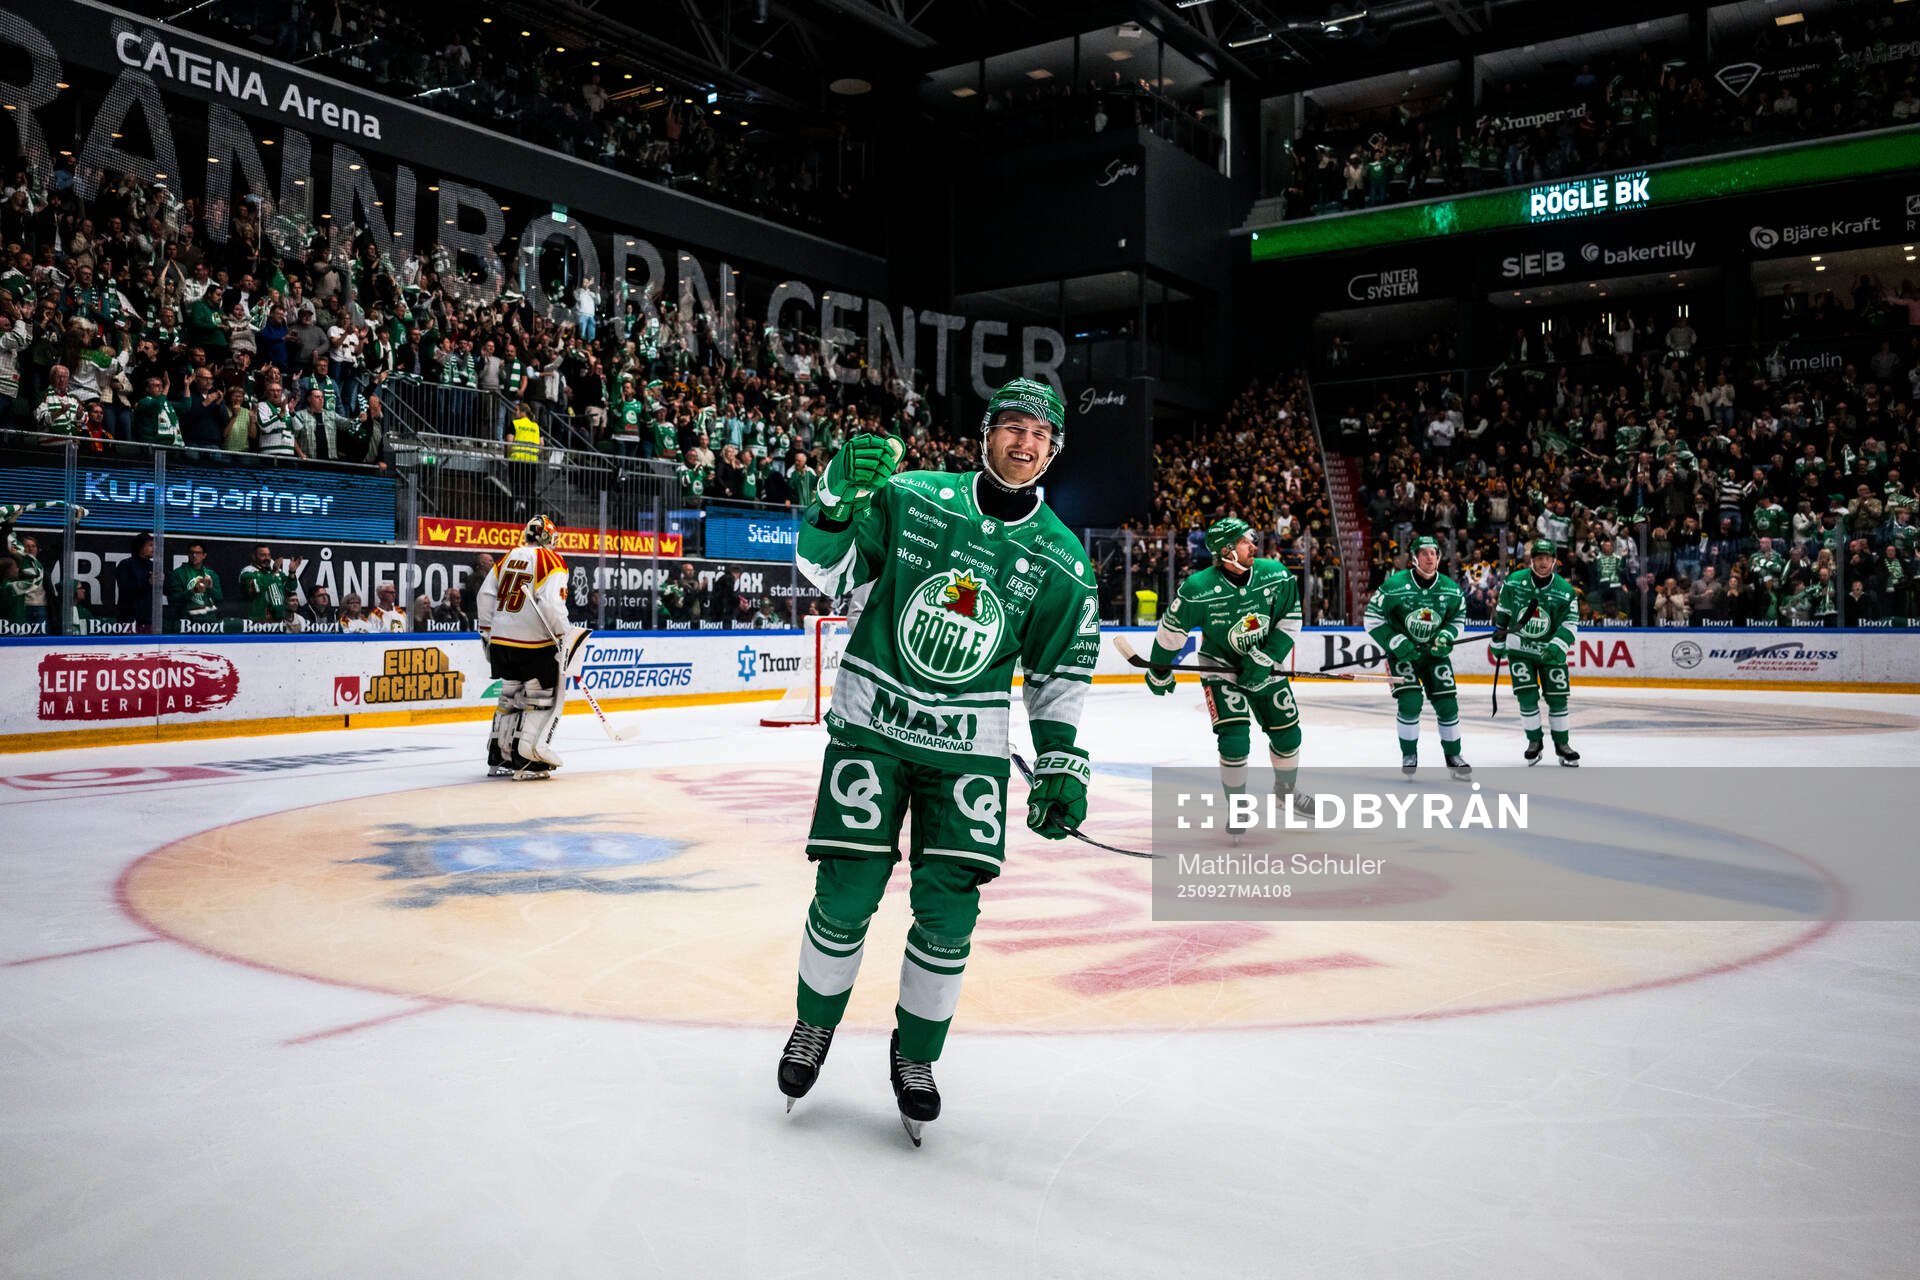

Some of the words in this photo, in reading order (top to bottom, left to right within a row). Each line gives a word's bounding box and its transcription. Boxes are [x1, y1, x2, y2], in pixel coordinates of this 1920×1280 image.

[116, 31, 268, 106] CATENA
[279, 84, 381, 140] Arena
[1530, 184, 1609, 217] RÖGLE
[1615, 177, 1650, 205] BK
[1783, 225, 1829, 245] Bjäre
[1831, 217, 1881, 237] Kraft
[1604, 240, 1696, 265] bakertilly
[1502, 250, 1566, 279] SEB
[1380, 268, 1419, 283] INTER
[1367, 281, 1419, 298] SYSTEM
[767, 280, 1067, 404] CENTER
[1790, 352, 1842, 370] melin
[85, 472, 334, 518] Kundpartner
[594, 533, 654, 553] KRONAN
[748, 524, 799, 544] Städni
[497, 571, 533, 613] 45
[89, 618, 137, 634] Boozt
[180, 618, 225, 634] Boozt
[242, 619, 285, 633] Boozt
[301, 618, 341, 633] Boozt
[427, 618, 461, 632] Boozt
[616, 618, 642, 630] Boozt
[666, 619, 691, 630] Boozt
[700, 619, 723, 630] Boozt
[731, 619, 754, 630] Boozt
[1702, 618, 1733, 627] Boozt
[1746, 618, 1778, 627] Boozt
[1791, 618, 1824, 627] Boozt
[1858, 618, 1893, 627] Boozt
[908, 608, 988, 674] RÖGLE
[385, 647, 440, 675] EURO
[583, 644, 644, 667] Tommy
[1793, 650, 1838, 660] BUSS
[43, 669, 88, 693] LEIF
[96, 667, 196, 692] OLSSONS
[364, 671, 460, 704] JACKPOT
[42, 696, 142, 715] MÅLERI
[166, 694, 193, 709] AB
[871, 687, 978, 741] MAXI
[886, 726, 973, 752] STORMARKNAD
